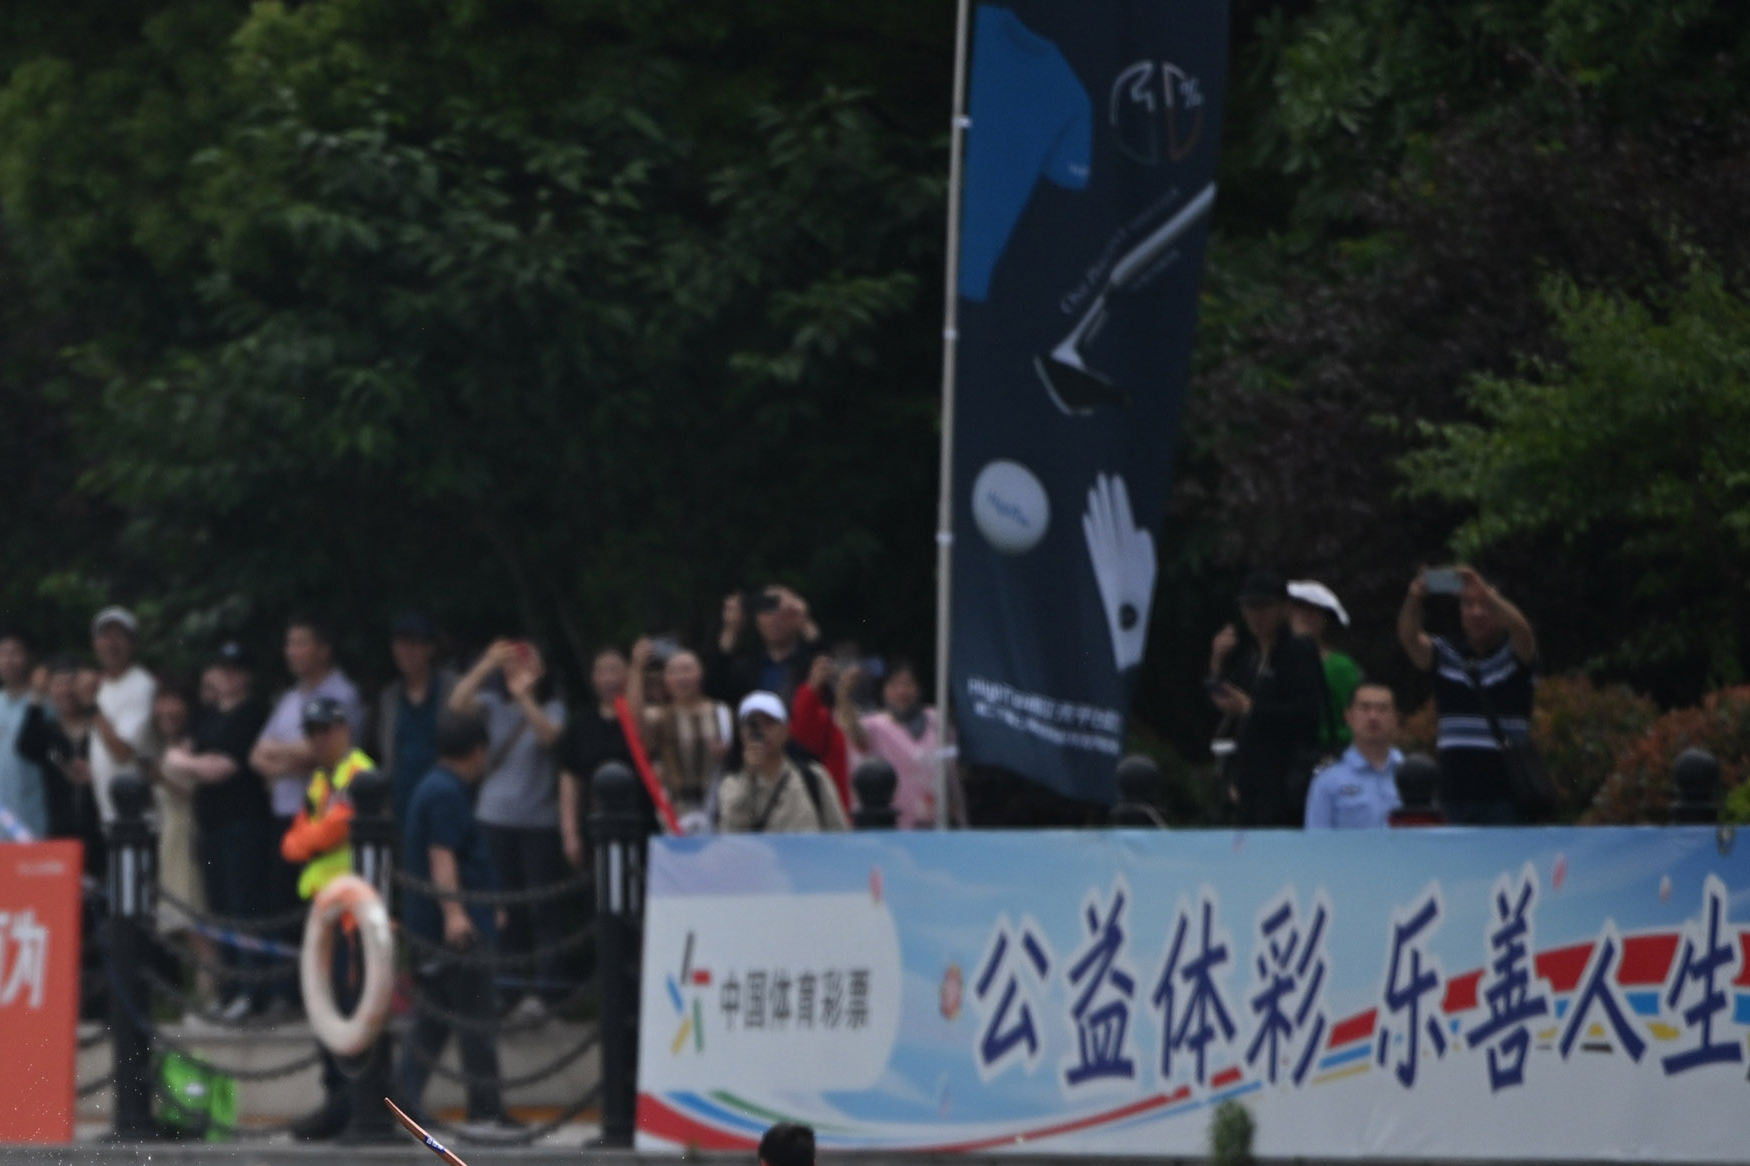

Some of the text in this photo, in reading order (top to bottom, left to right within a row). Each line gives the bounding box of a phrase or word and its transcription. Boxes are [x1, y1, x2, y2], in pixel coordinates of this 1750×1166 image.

[720, 966, 871, 1031] 中国体育彩票
[974, 877, 1744, 1095] 公益体彩 乐善人生
